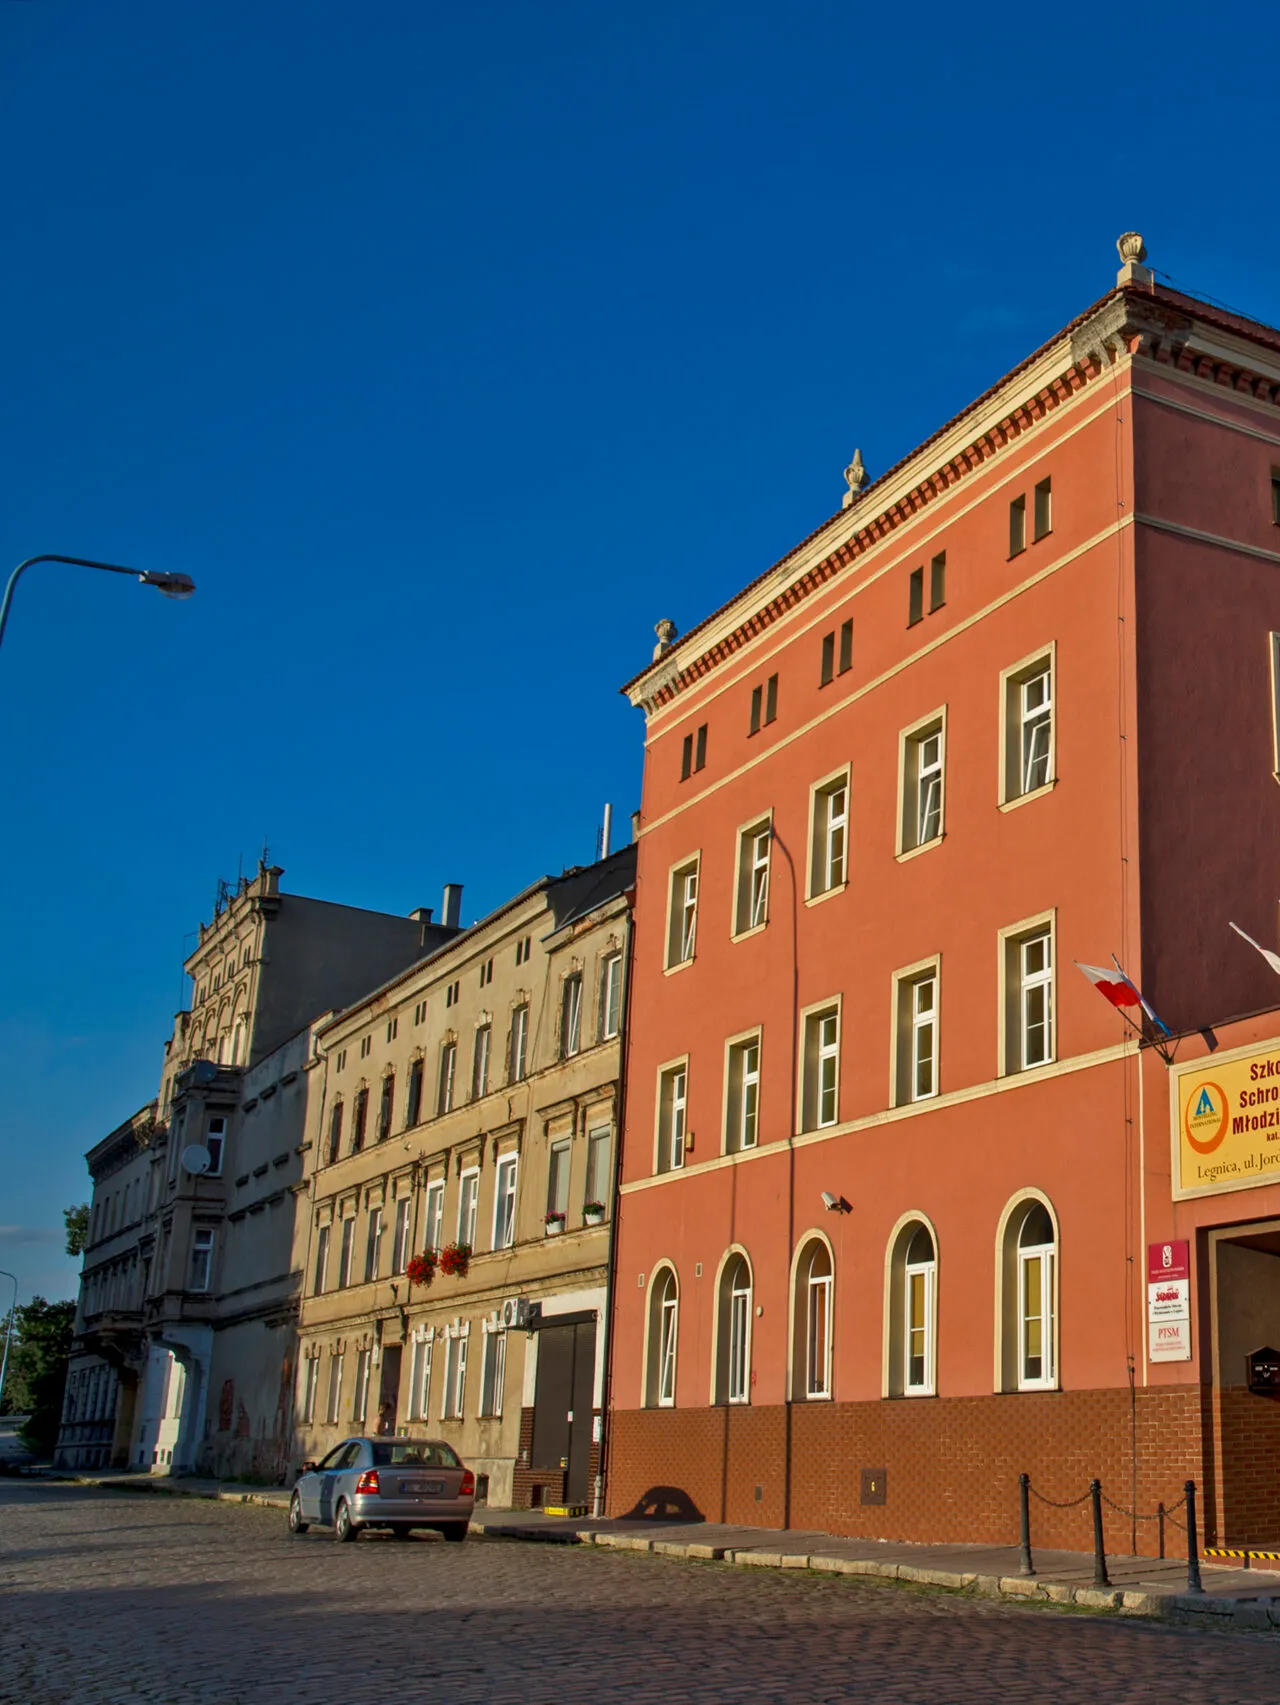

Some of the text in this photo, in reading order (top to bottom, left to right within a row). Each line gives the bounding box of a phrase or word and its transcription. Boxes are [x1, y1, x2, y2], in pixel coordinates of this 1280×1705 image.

[1266, 1131, 1280, 1142] kat.
[1197, 1162, 1241, 1181] Legnica,
[1244, 1154, 1258, 1169] ul.
[1158, 1327, 1179, 1339] PTSM
